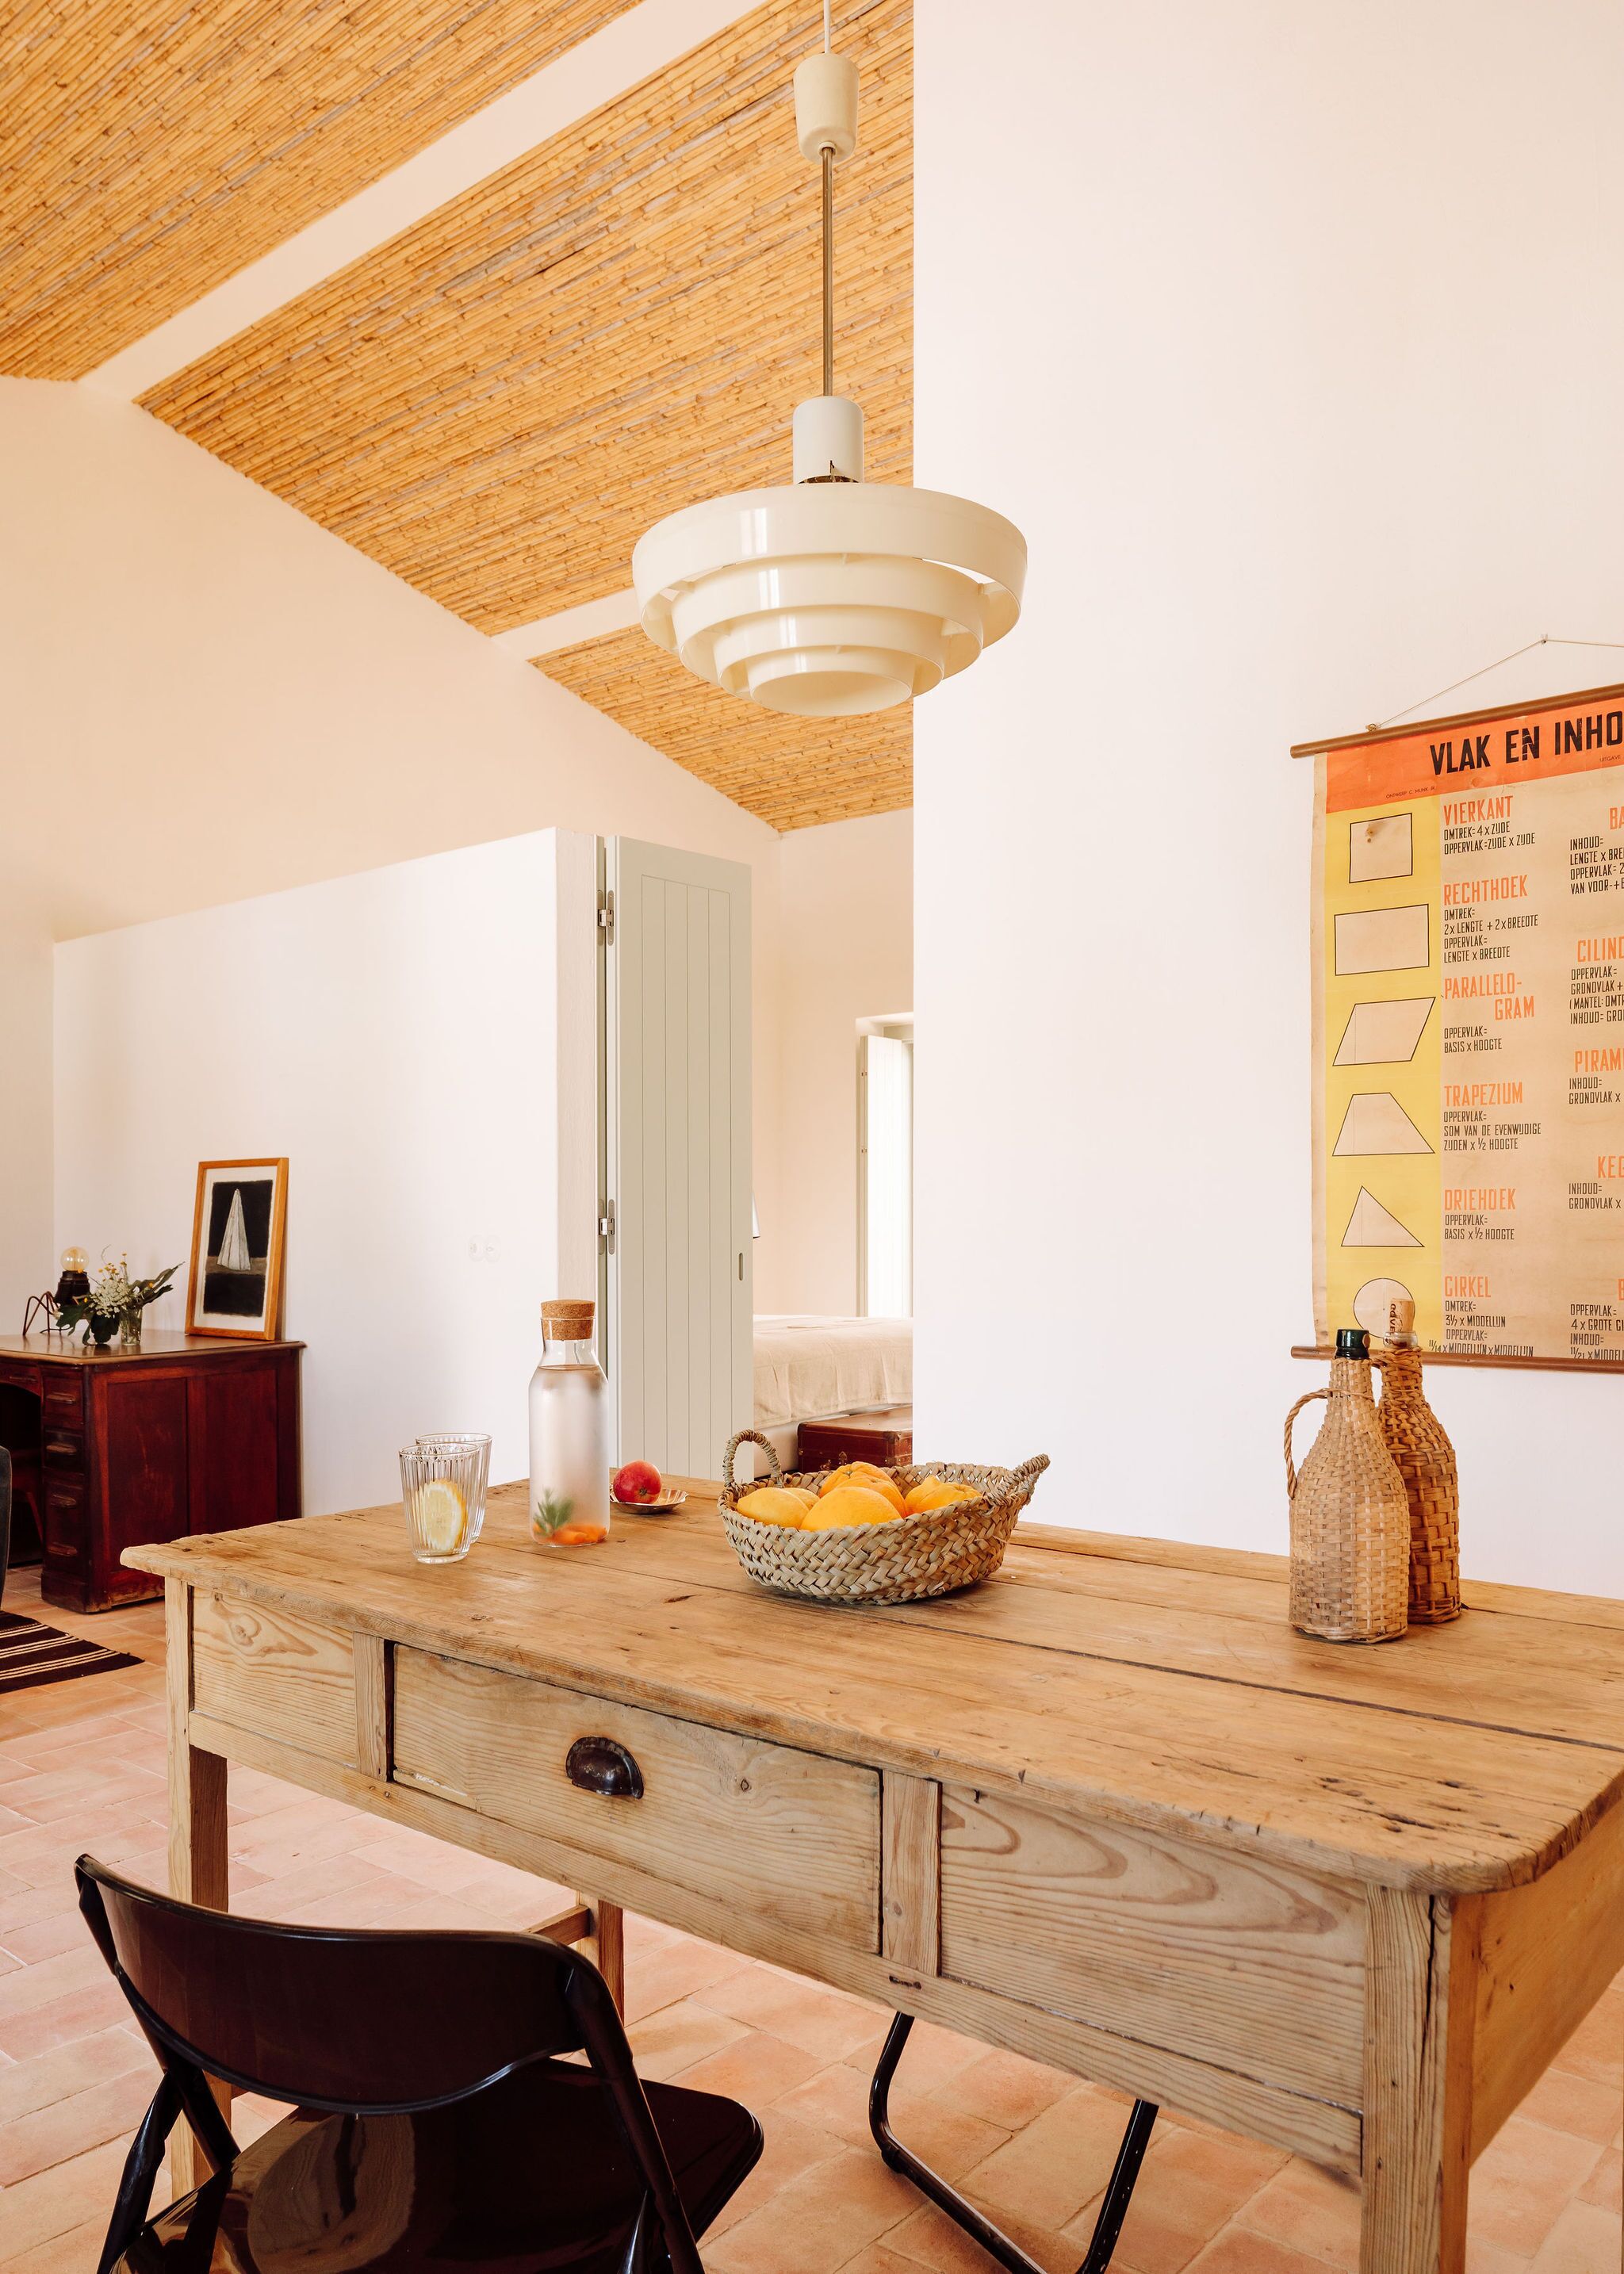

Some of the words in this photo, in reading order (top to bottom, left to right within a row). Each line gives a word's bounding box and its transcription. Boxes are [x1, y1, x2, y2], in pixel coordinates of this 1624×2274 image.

[1430, 734, 1491, 775] VLAK
[1506, 726, 1539, 764] EN
[1555, 710, 1623, 756] INHO
[1443, 795, 1514, 825] VIERKANT
[1444, 826, 1475, 840] OMTREK=
[1477, 825, 1483, 836] 4
[1570, 836, 1603, 851] INHOUD=
[1570, 851, 1598, 865] LENGTE
[1570, 864, 1617, 880] OPPERVLAK=
[1443, 875, 1528, 905] RECHTHOEK
[1571, 882, 1584, 894] VAN
[1444, 907, 1475, 921] OMTREK=
[1457, 920, 1483, 934] LENGTE
[1444, 935, 1488, 949] OPPERVLAK=
[1443, 950, 1469, 963] LENGTE
[1480, 946, 1511, 960] BREEDTE
[1444, 972, 1522, 999] PARALLELO-
[1571, 980, 1614, 995] GRONDVLAK
[1495, 995, 1534, 1020] GRAM
[1570, 1011, 1604, 1024] INHOUD=
[1444, 1025, 1488, 1039] OPPERVLAK=
[1444, 1041, 1465, 1053] BASIS
[1473, 1038, 1503, 1051] HOOGTE
[1569, 1077, 1603, 1089] INHOUD=
[1443, 1081, 1523, 1107] TRAPEZIUM
[1569, 1090, 1613, 1104] GRONDVLAK
[1443, 1111, 1487, 1123] OPPERVLAK=
[1444, 1125, 1460, 1137] SOM
[1464, 1124, 1477, 1136] VAN
[1481, 1124, 1491, 1136] DE
[1489, 1138, 1519, 1150] HOOGTE
[1568, 1182, 1603, 1195] INHOUD=
[1444, 1188, 1516, 1211] DRIEHOEK
[1568, 1197, 1613, 1210] GRONDVLAK
[1445, 1214, 1488, 1226] OPPERVLAK=
[1444, 1228, 1465, 1240] BASIS
[1485, 1228, 1515, 1240] HOOGTE
[1444, 1276, 1492, 1298] CIRKEL
[1445, 1300, 1477, 1312] OMTREK=
[1570, 1304, 1617, 1317] OPPERVLAK=
[1571, 1319, 1578, 1330] 4
[1588, 1319, 1612, 1331] GROTE
[1446, 1329, 1488, 1341] OPPERVLAK=
[1570, 1333, 1604, 1346] INHOUD=
